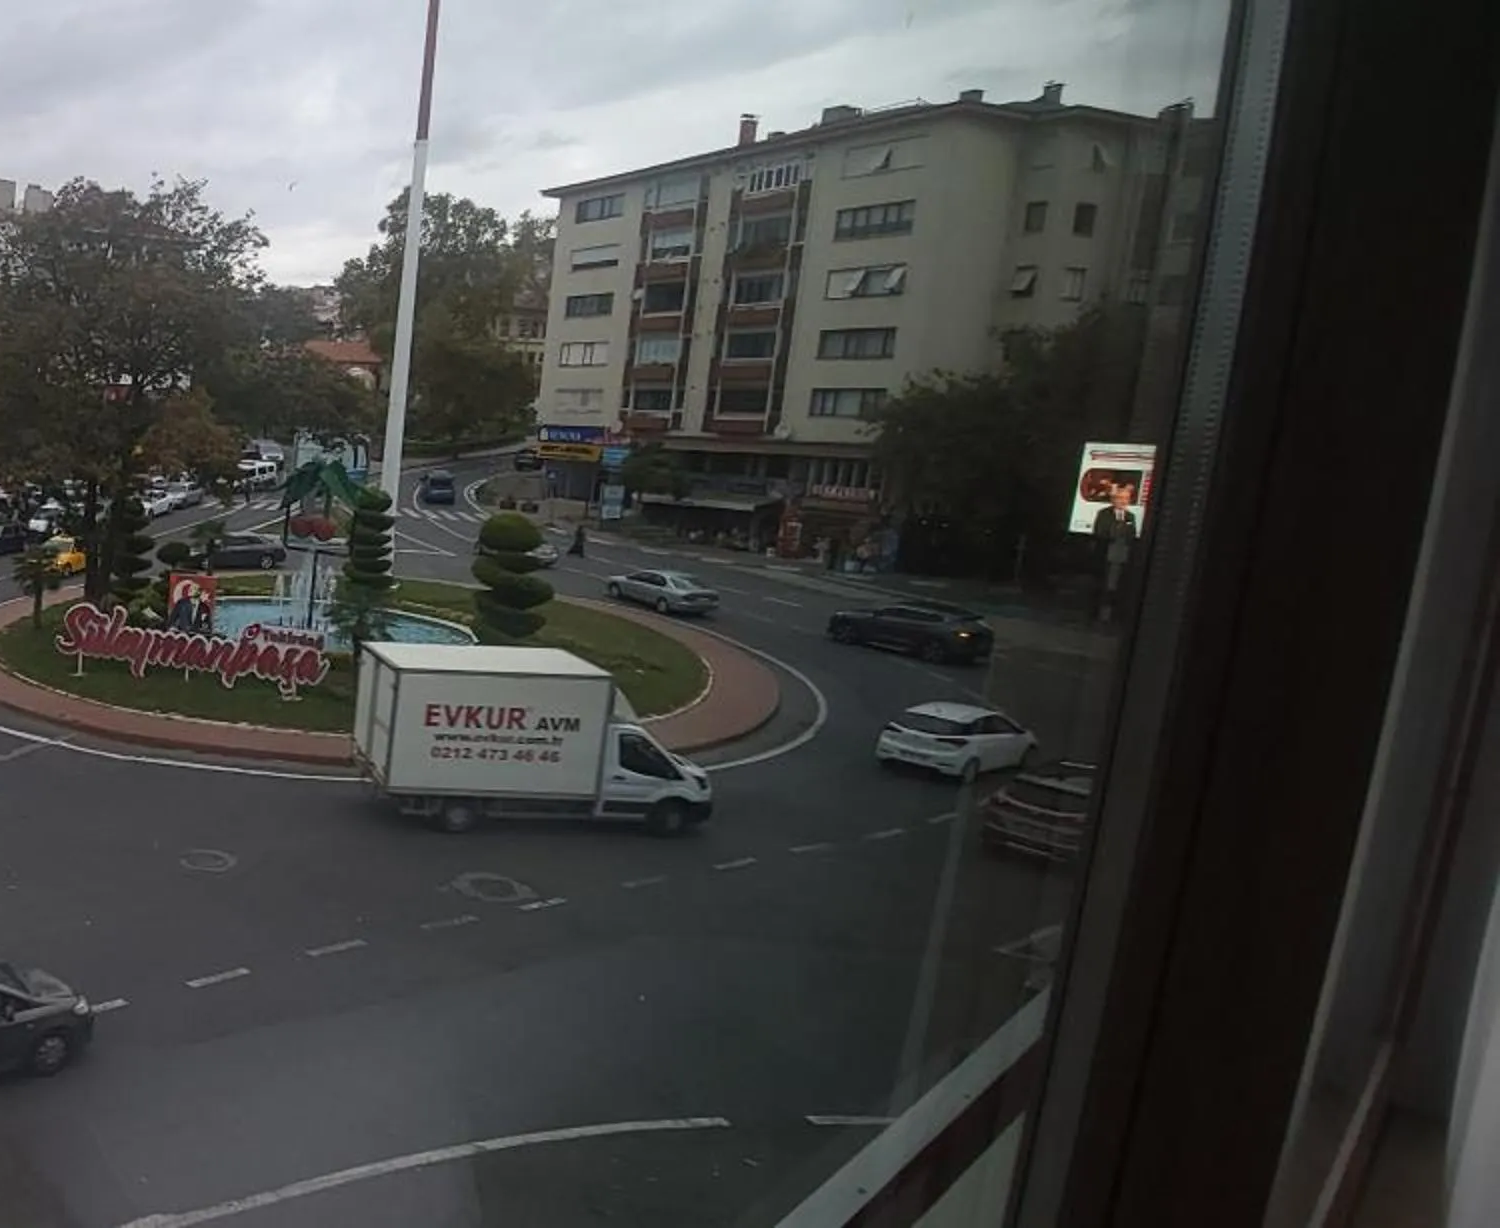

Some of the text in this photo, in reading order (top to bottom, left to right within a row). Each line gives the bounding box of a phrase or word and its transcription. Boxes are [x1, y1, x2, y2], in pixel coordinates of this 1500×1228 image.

[424, 703, 581, 732] EVKUR AVM
[433, 733, 564, 747] www.evkur.com.tr
[430, 746, 472, 759] 0212
[477, 748, 508, 761] 473
